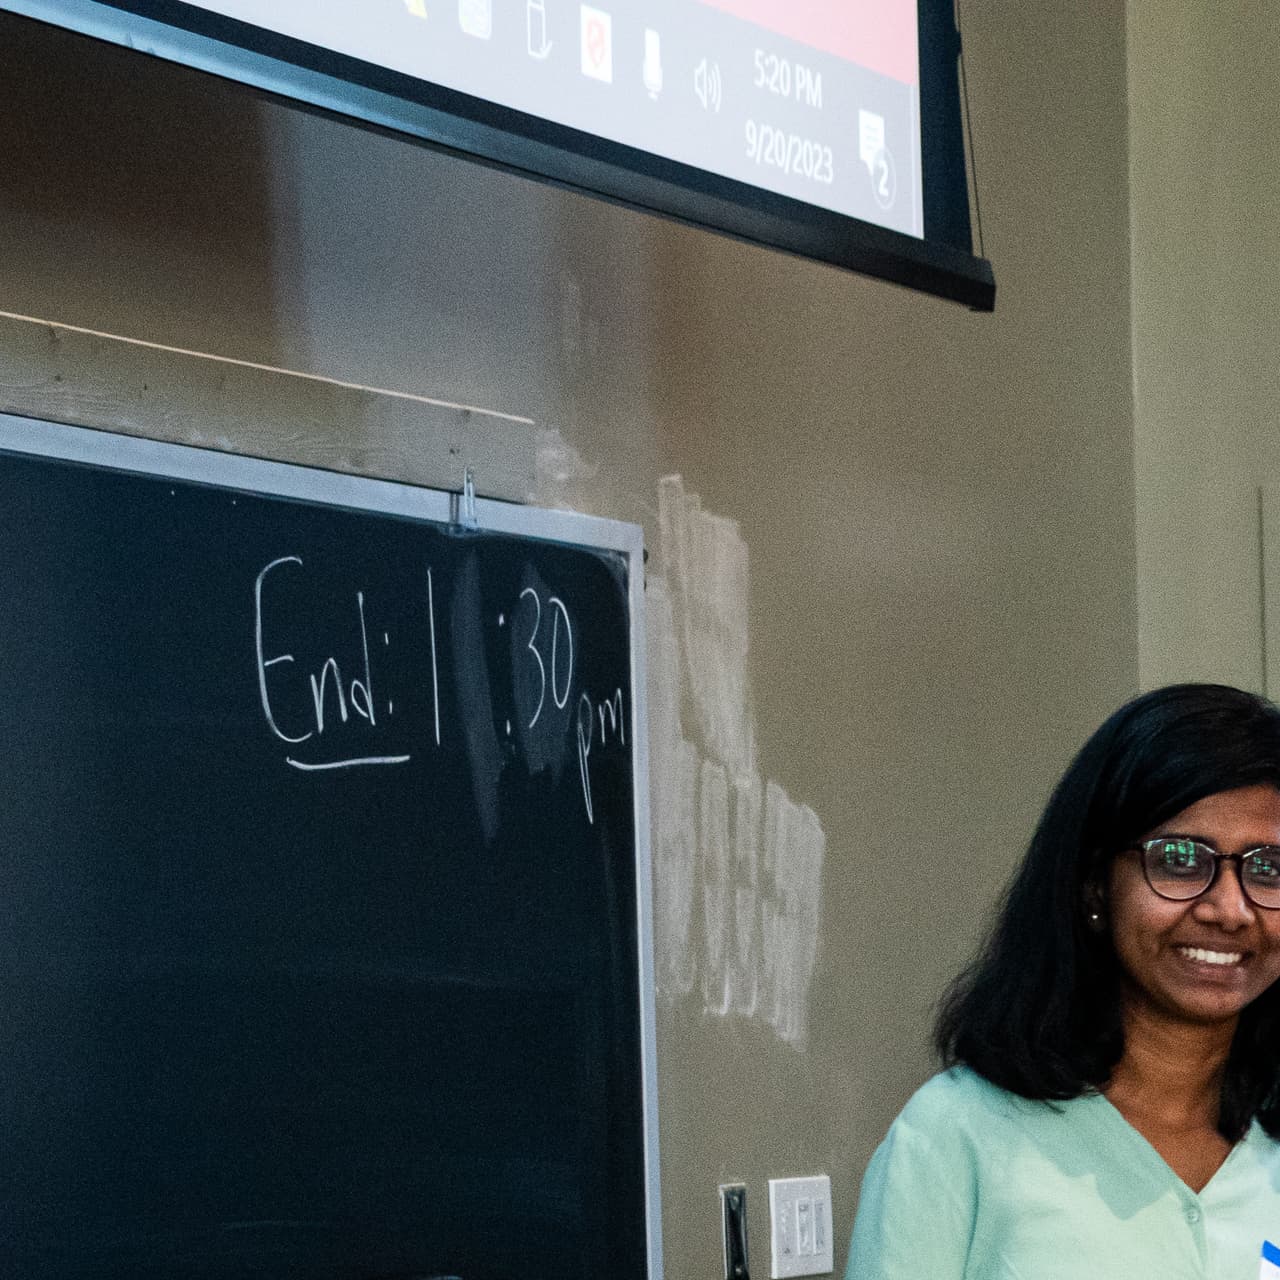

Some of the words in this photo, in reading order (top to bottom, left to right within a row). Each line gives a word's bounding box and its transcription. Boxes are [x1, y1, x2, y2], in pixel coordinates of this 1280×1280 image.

[753, 48, 792, 97] 5:20
[794, 63, 823, 109] PM
[745, 118, 834, 184] 9/20/2023
[876, 158, 890, 197] 2
[256, 556, 395, 743] End:
[576, 687, 627, 826] pm
